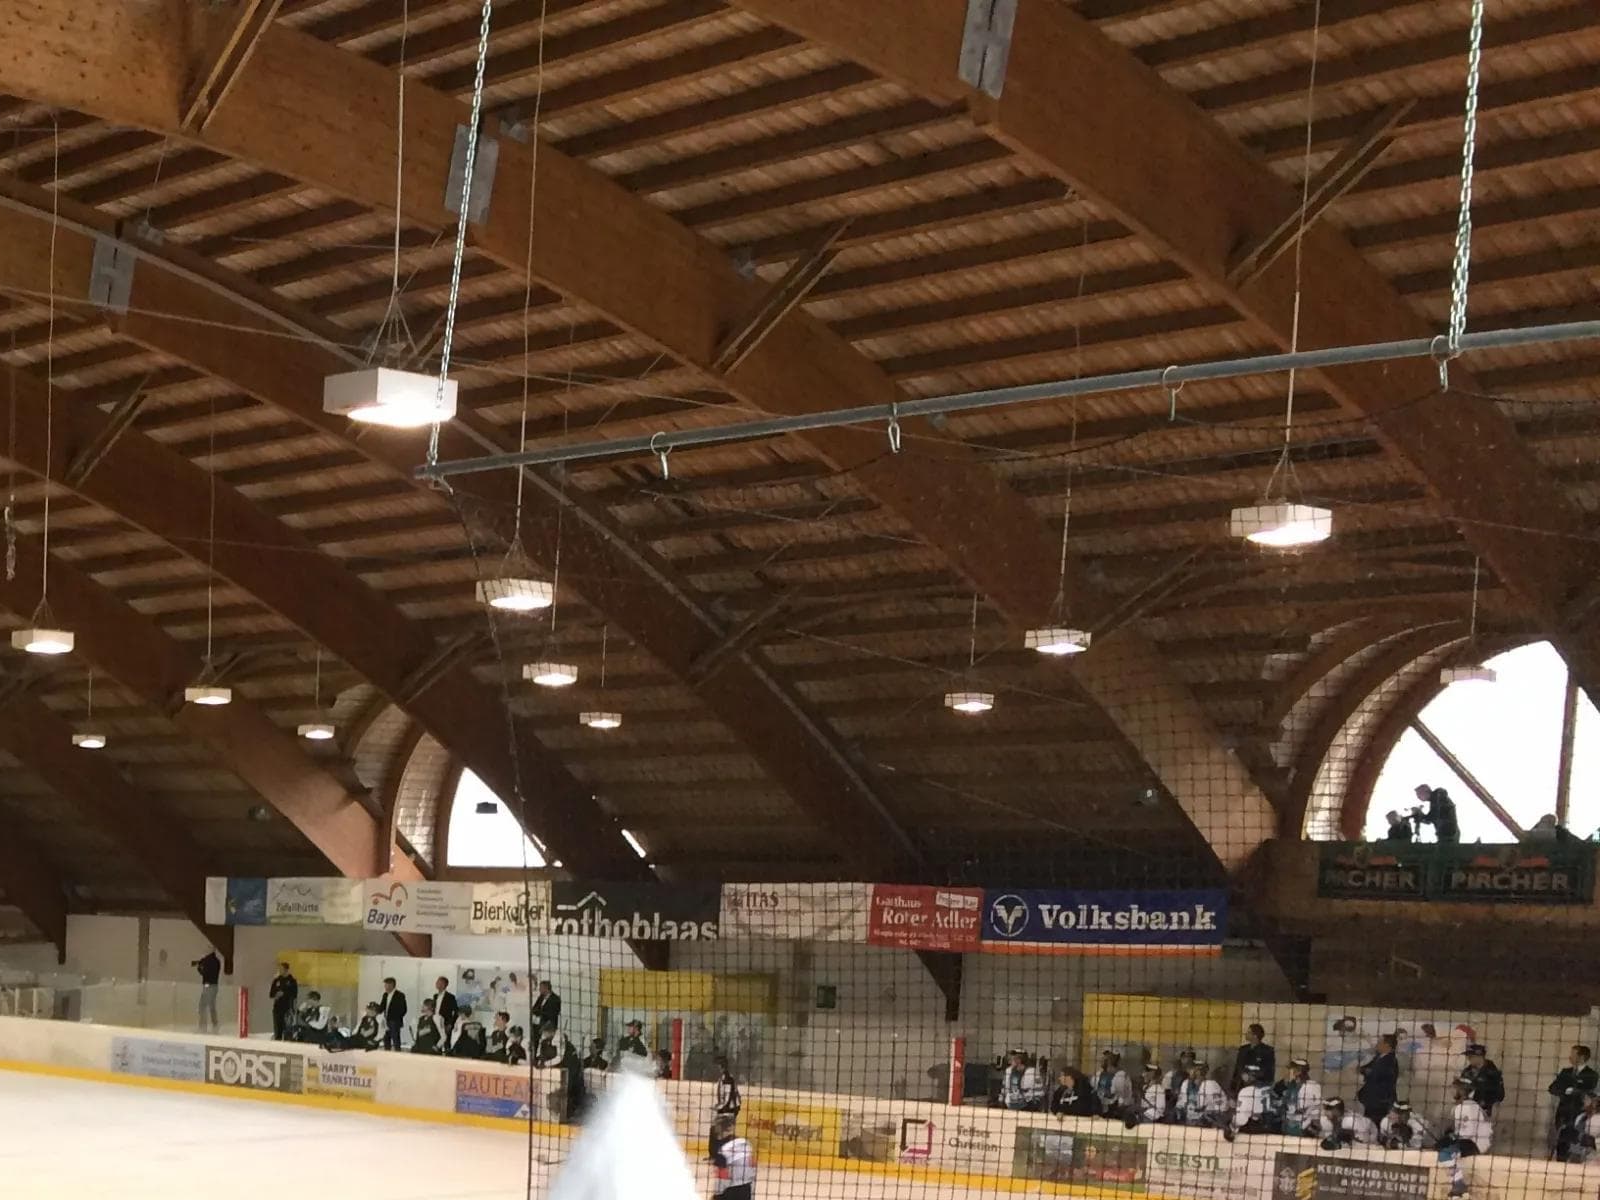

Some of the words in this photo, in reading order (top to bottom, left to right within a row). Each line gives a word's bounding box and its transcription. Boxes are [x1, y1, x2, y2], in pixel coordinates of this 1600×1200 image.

[1451, 871, 1570, 892] PIRCHER
[366, 908, 408, 929] Bayer
[1037, 903, 1218, 932] Volksbank
[209, 1050, 288, 1088] FORST
